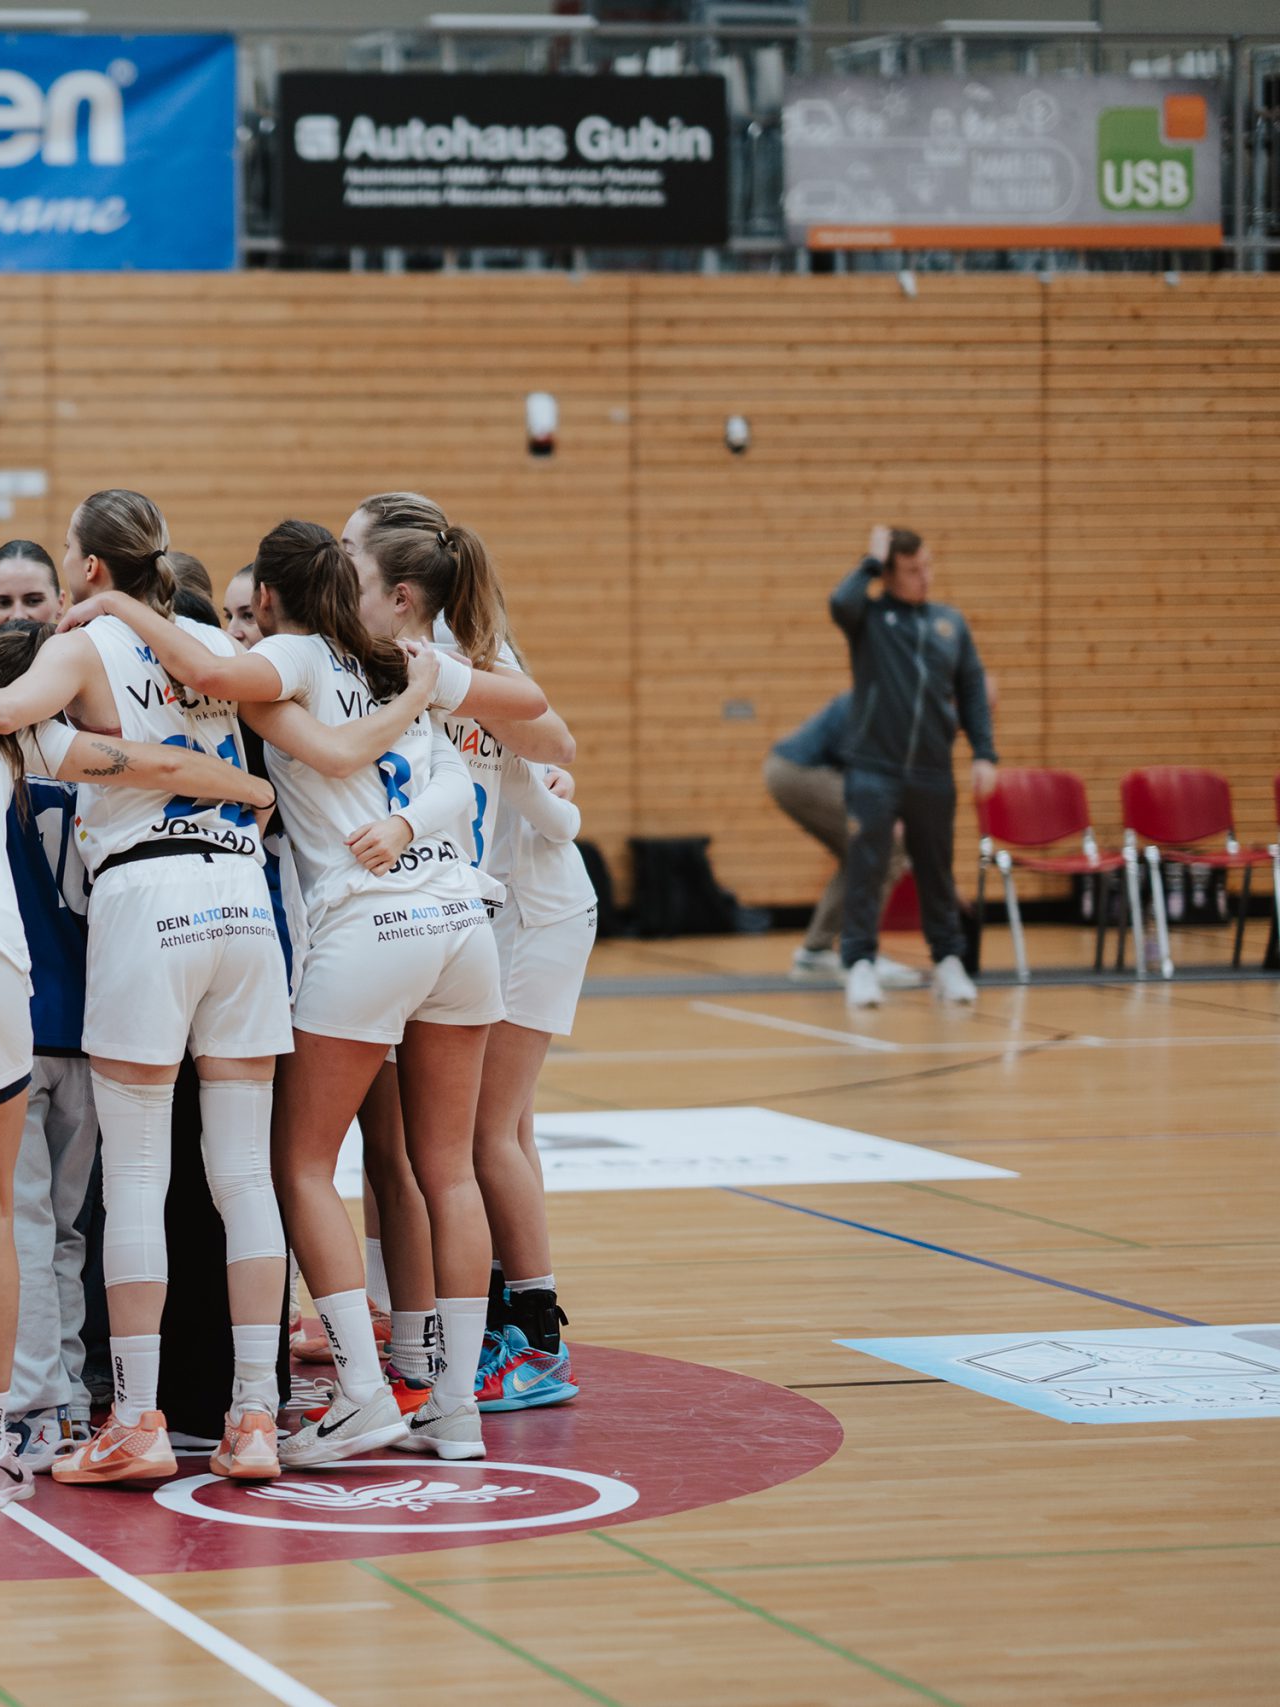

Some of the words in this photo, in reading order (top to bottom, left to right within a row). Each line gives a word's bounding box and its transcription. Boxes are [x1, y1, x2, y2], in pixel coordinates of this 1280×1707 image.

[344, 115, 568, 160] Autohaus
[575, 116, 713, 161] Gubin
[1102, 159, 1189, 207] USB
[156, 915, 190, 932] DEIN
[373, 910, 408, 926] DEIN
[441, 901, 470, 916] DEIN
[160, 931, 206, 948] Athletic
[377, 926, 425, 942] Athletic
[426, 923, 450, 936] Sport
[321, 1314, 341, 1350] CRAFT
[115, 1356, 125, 1390] CRAFT
